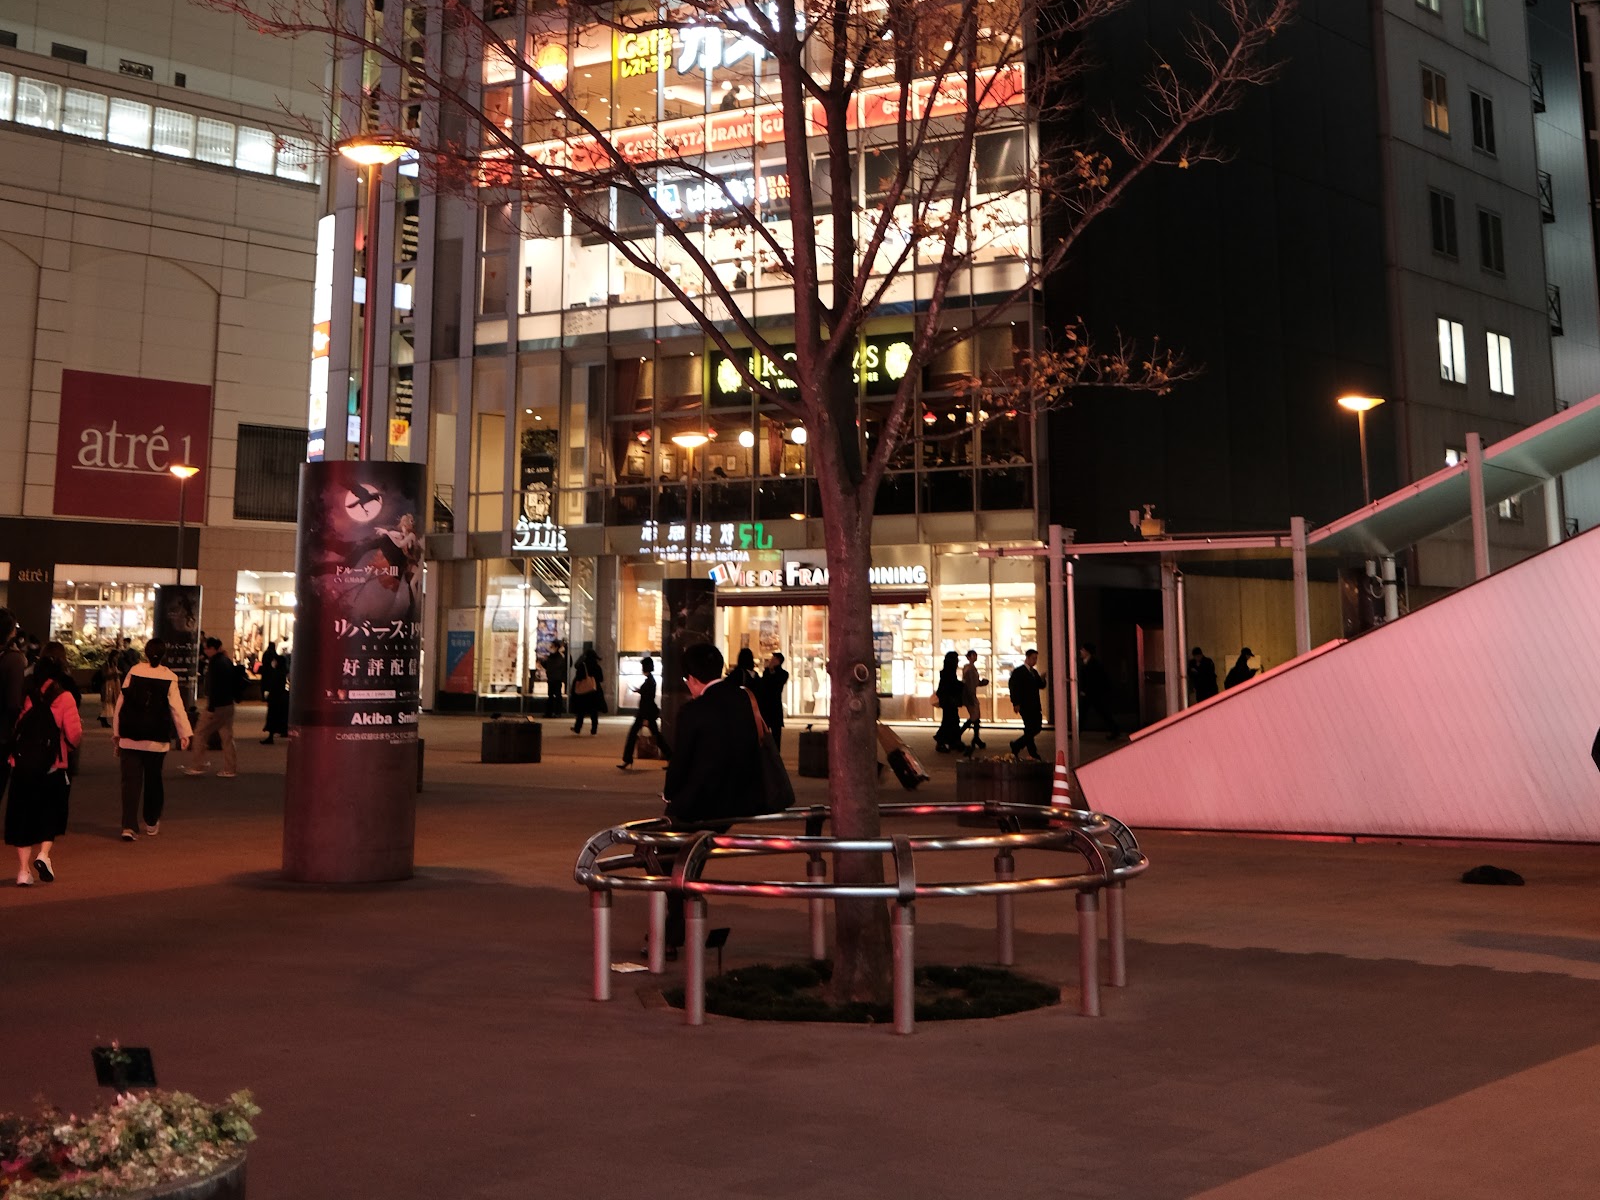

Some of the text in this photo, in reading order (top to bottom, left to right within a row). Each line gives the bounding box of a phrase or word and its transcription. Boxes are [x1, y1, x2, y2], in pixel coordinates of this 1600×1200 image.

[618, 28, 673, 60] Café
[620, 54, 673, 79] レストラン
[763, 115, 785, 134] GU
[766, 174, 790, 188] HA
[77, 419, 192, 472] atré 1
[350, 711, 393, 726] Akiba
